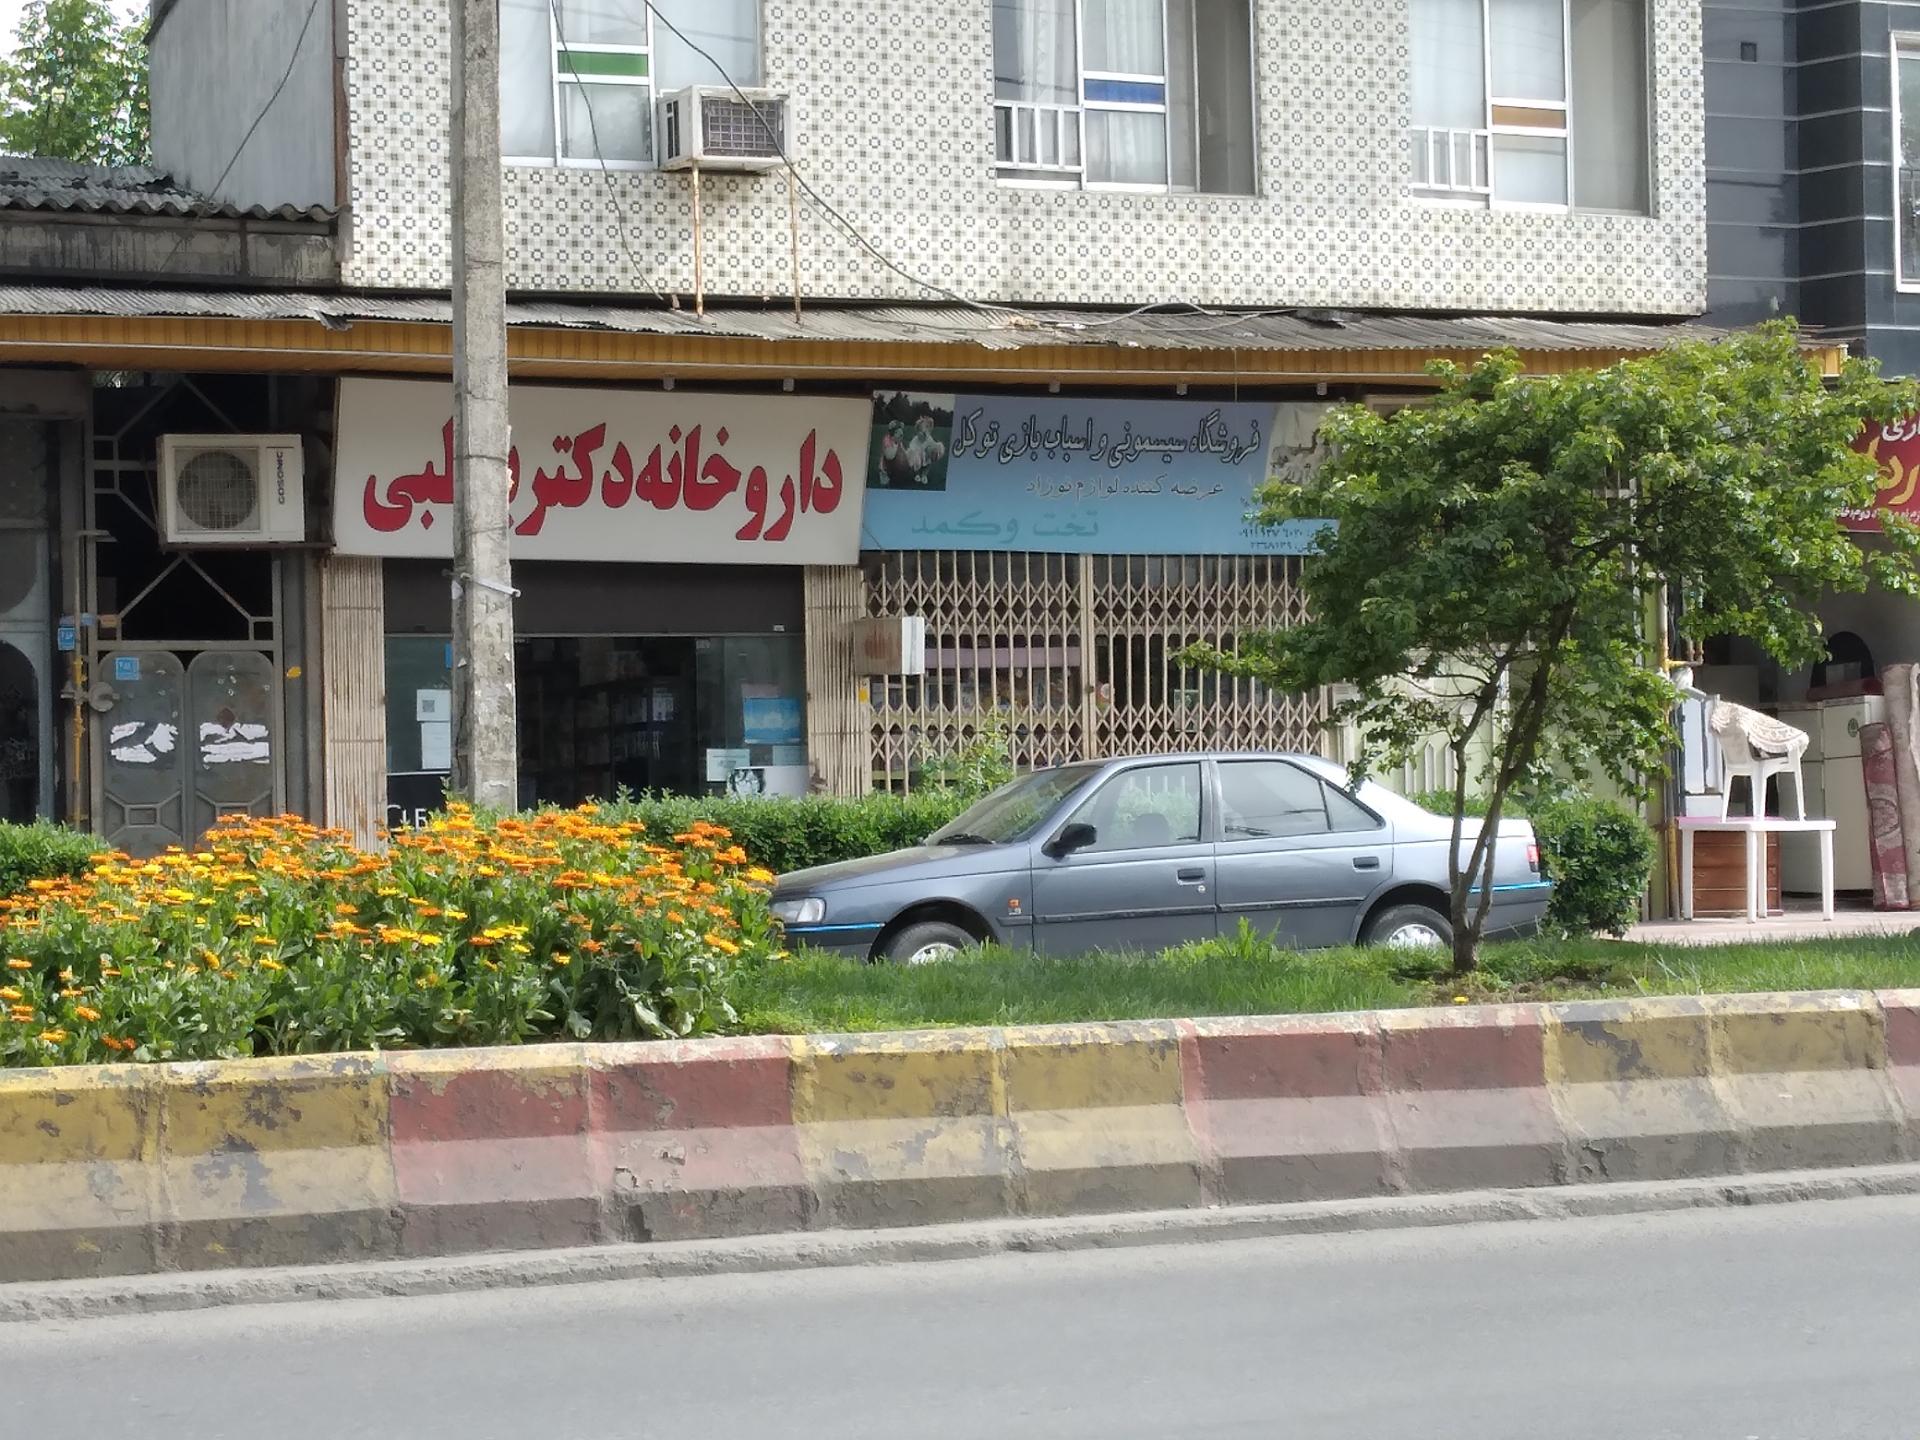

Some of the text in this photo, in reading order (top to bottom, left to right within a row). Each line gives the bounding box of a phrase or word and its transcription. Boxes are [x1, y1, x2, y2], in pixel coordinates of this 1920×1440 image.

[952, 408, 1000, 460] توکل
[1107, 421, 1187, 468] سیسمونی
[1189, 408, 1261, 464] فروشگاه
[515, 422, 633, 536] دکتر
[1170, 481, 1224, 500] عرضه
[1032, 509, 1099, 537] تخت
